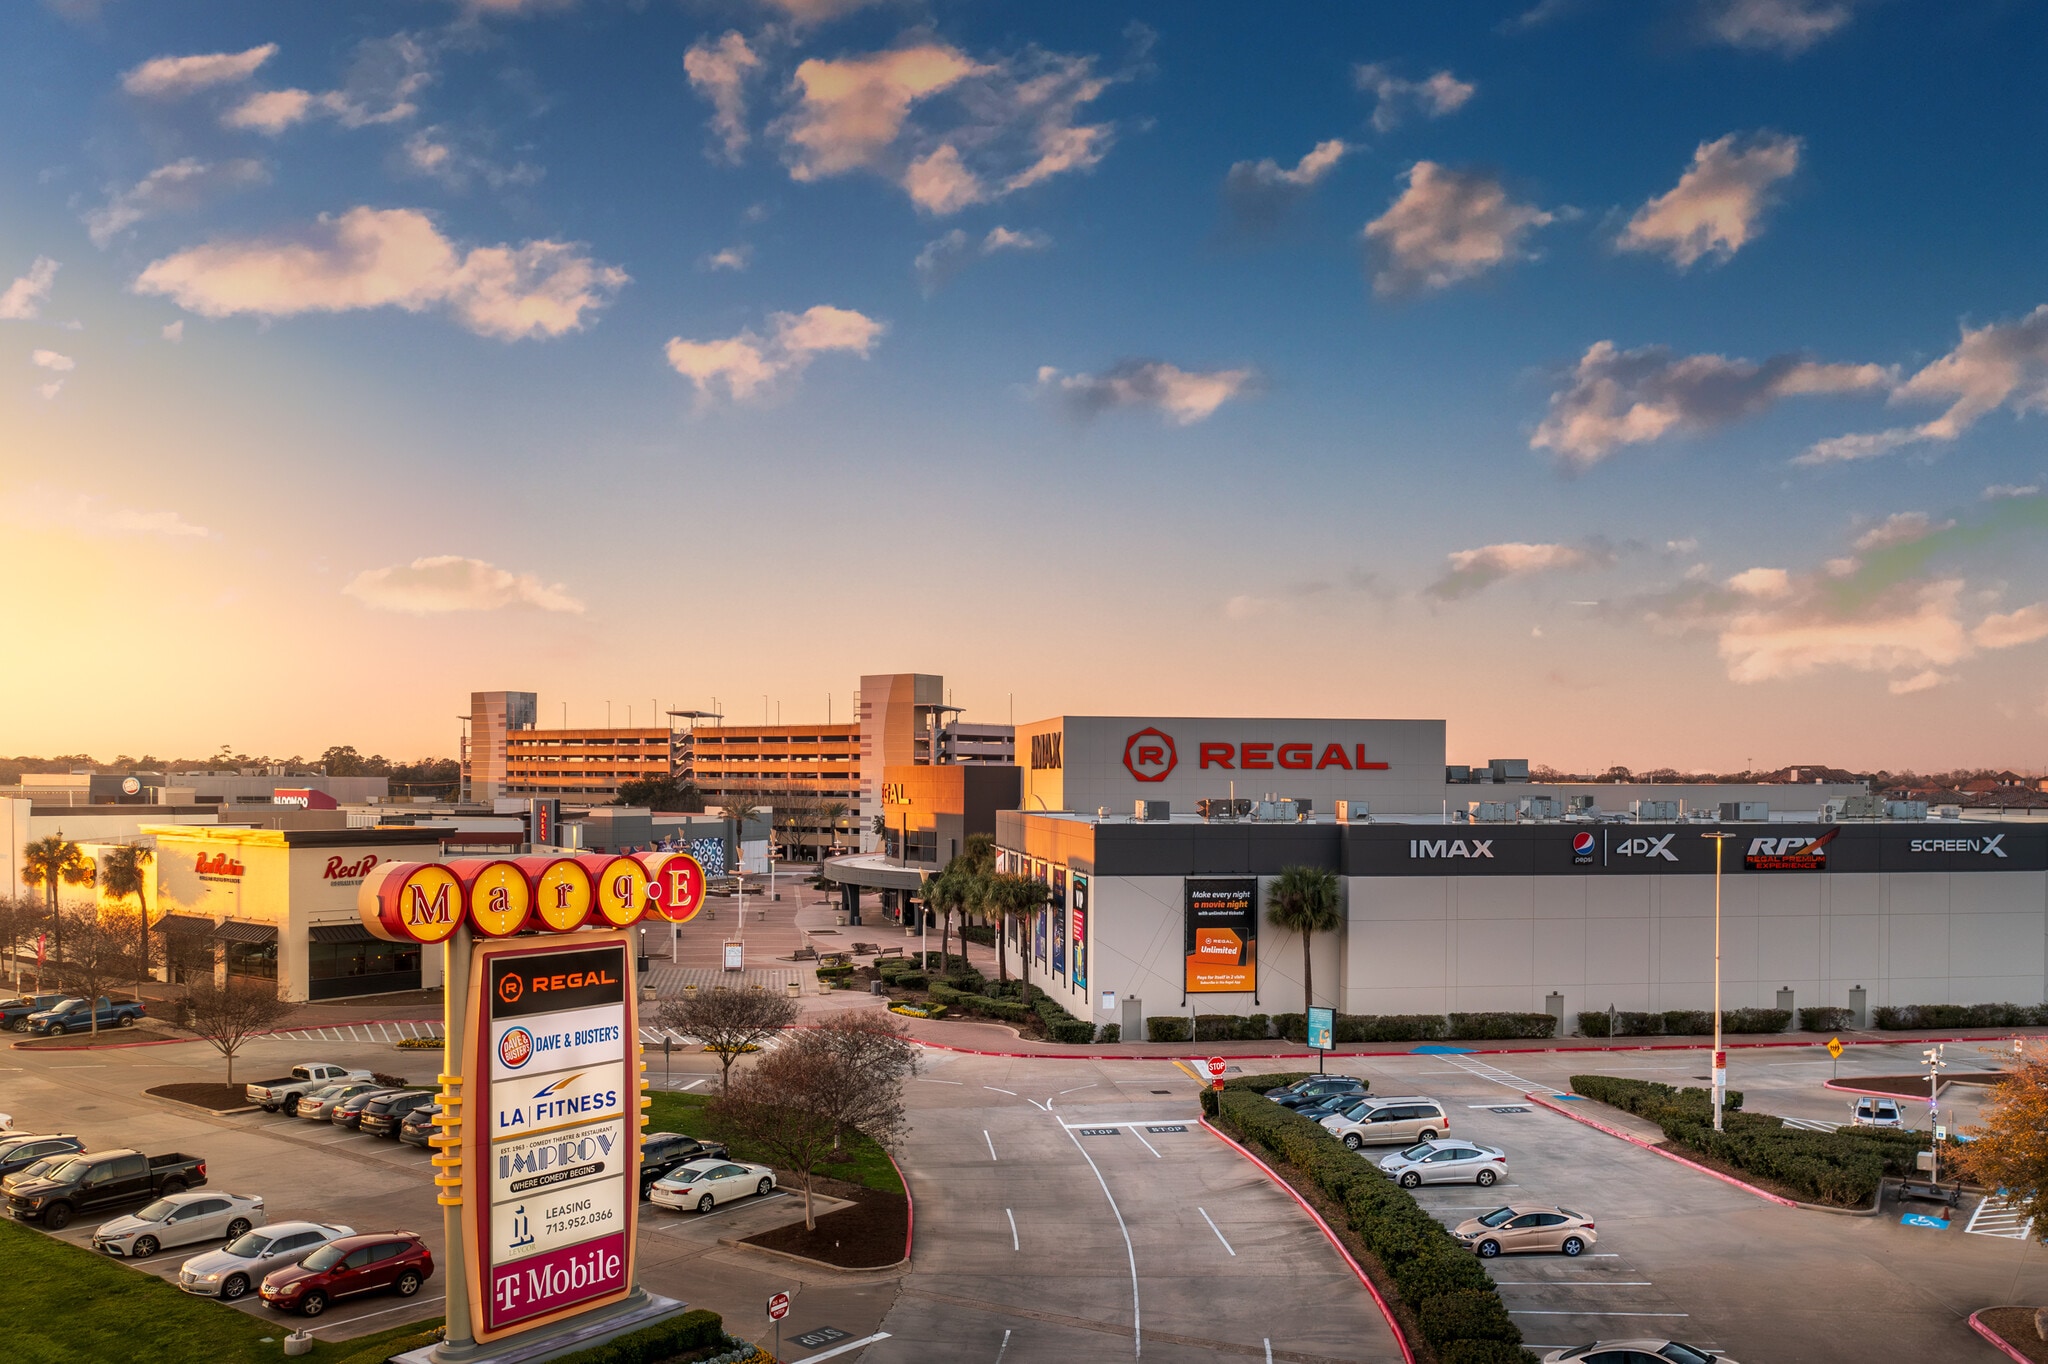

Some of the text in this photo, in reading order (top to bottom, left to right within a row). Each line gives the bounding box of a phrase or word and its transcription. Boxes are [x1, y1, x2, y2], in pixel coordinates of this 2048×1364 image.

[1031, 731, 1062, 769] IMAX
[1199, 743, 1391, 770] REGAL
[1409, 839, 1494, 859] IMAX
[1616, 833, 1679, 862] 4DX
[1747, 831, 1832, 856] RPX
[1574, 855, 1593, 865] pepsi
[1746, 855, 1826, 863] REGAL PREMIUM
[1201, 900, 1225, 908] movie
[1227, 900, 1248, 910] night
[1212, 891, 1232, 900] every
[1232, 891, 1250, 900] night
[1201, 946, 1238, 955] Unlimited
[532, 970, 617, 993] REGAL
[504, 1036, 523, 1052] DAVE
[536, 1025, 619, 1052] DAVE & BUSTER'S
[1209, 1061, 1225, 1071] STOP
[500, 1090, 617, 1128] LA FITNESS
[512, 1144, 525, 1152] 1963
[529, 1139, 551, 1149] COMEDY
[553, 1134, 575, 1143] THEATRE
[581, 1126, 613, 1137] RESTAURANT
[499, 1132, 618, 1180] IMPROV
[512, 1165, 596, 1191] WHERE COMEDY BEGINS
[545, 1199, 592, 1219] LEASING
[545, 1208, 613, 1235] 713.952.0366
[526, 1249, 620, 1304] Mobile
[774, 1308, 785, 1316] ENTER
[800, 1328, 844, 1346] STOP
